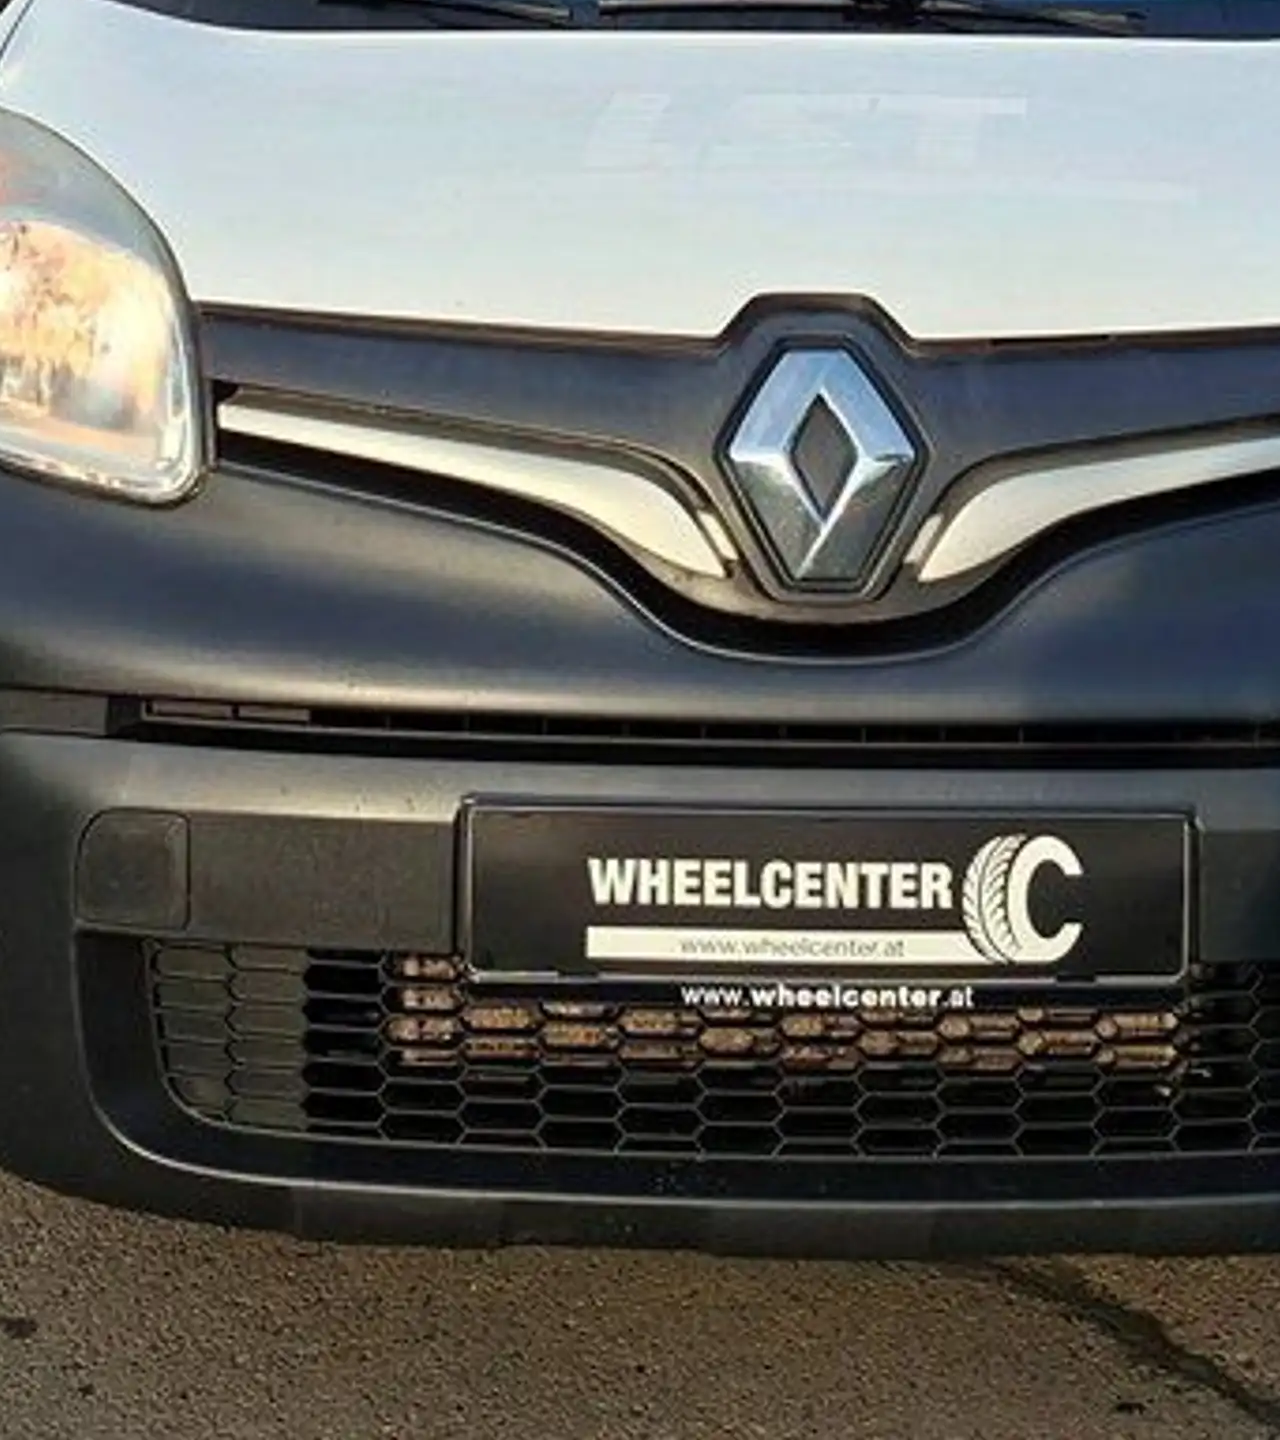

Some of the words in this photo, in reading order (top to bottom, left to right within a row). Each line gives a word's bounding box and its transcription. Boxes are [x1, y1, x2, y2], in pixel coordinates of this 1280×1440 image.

[587, 856, 953, 910] WHEELCENTER
[679, 933, 905, 959] www.wheelcenter.at
[681, 982, 975, 1010] www.wheelcenter.at
